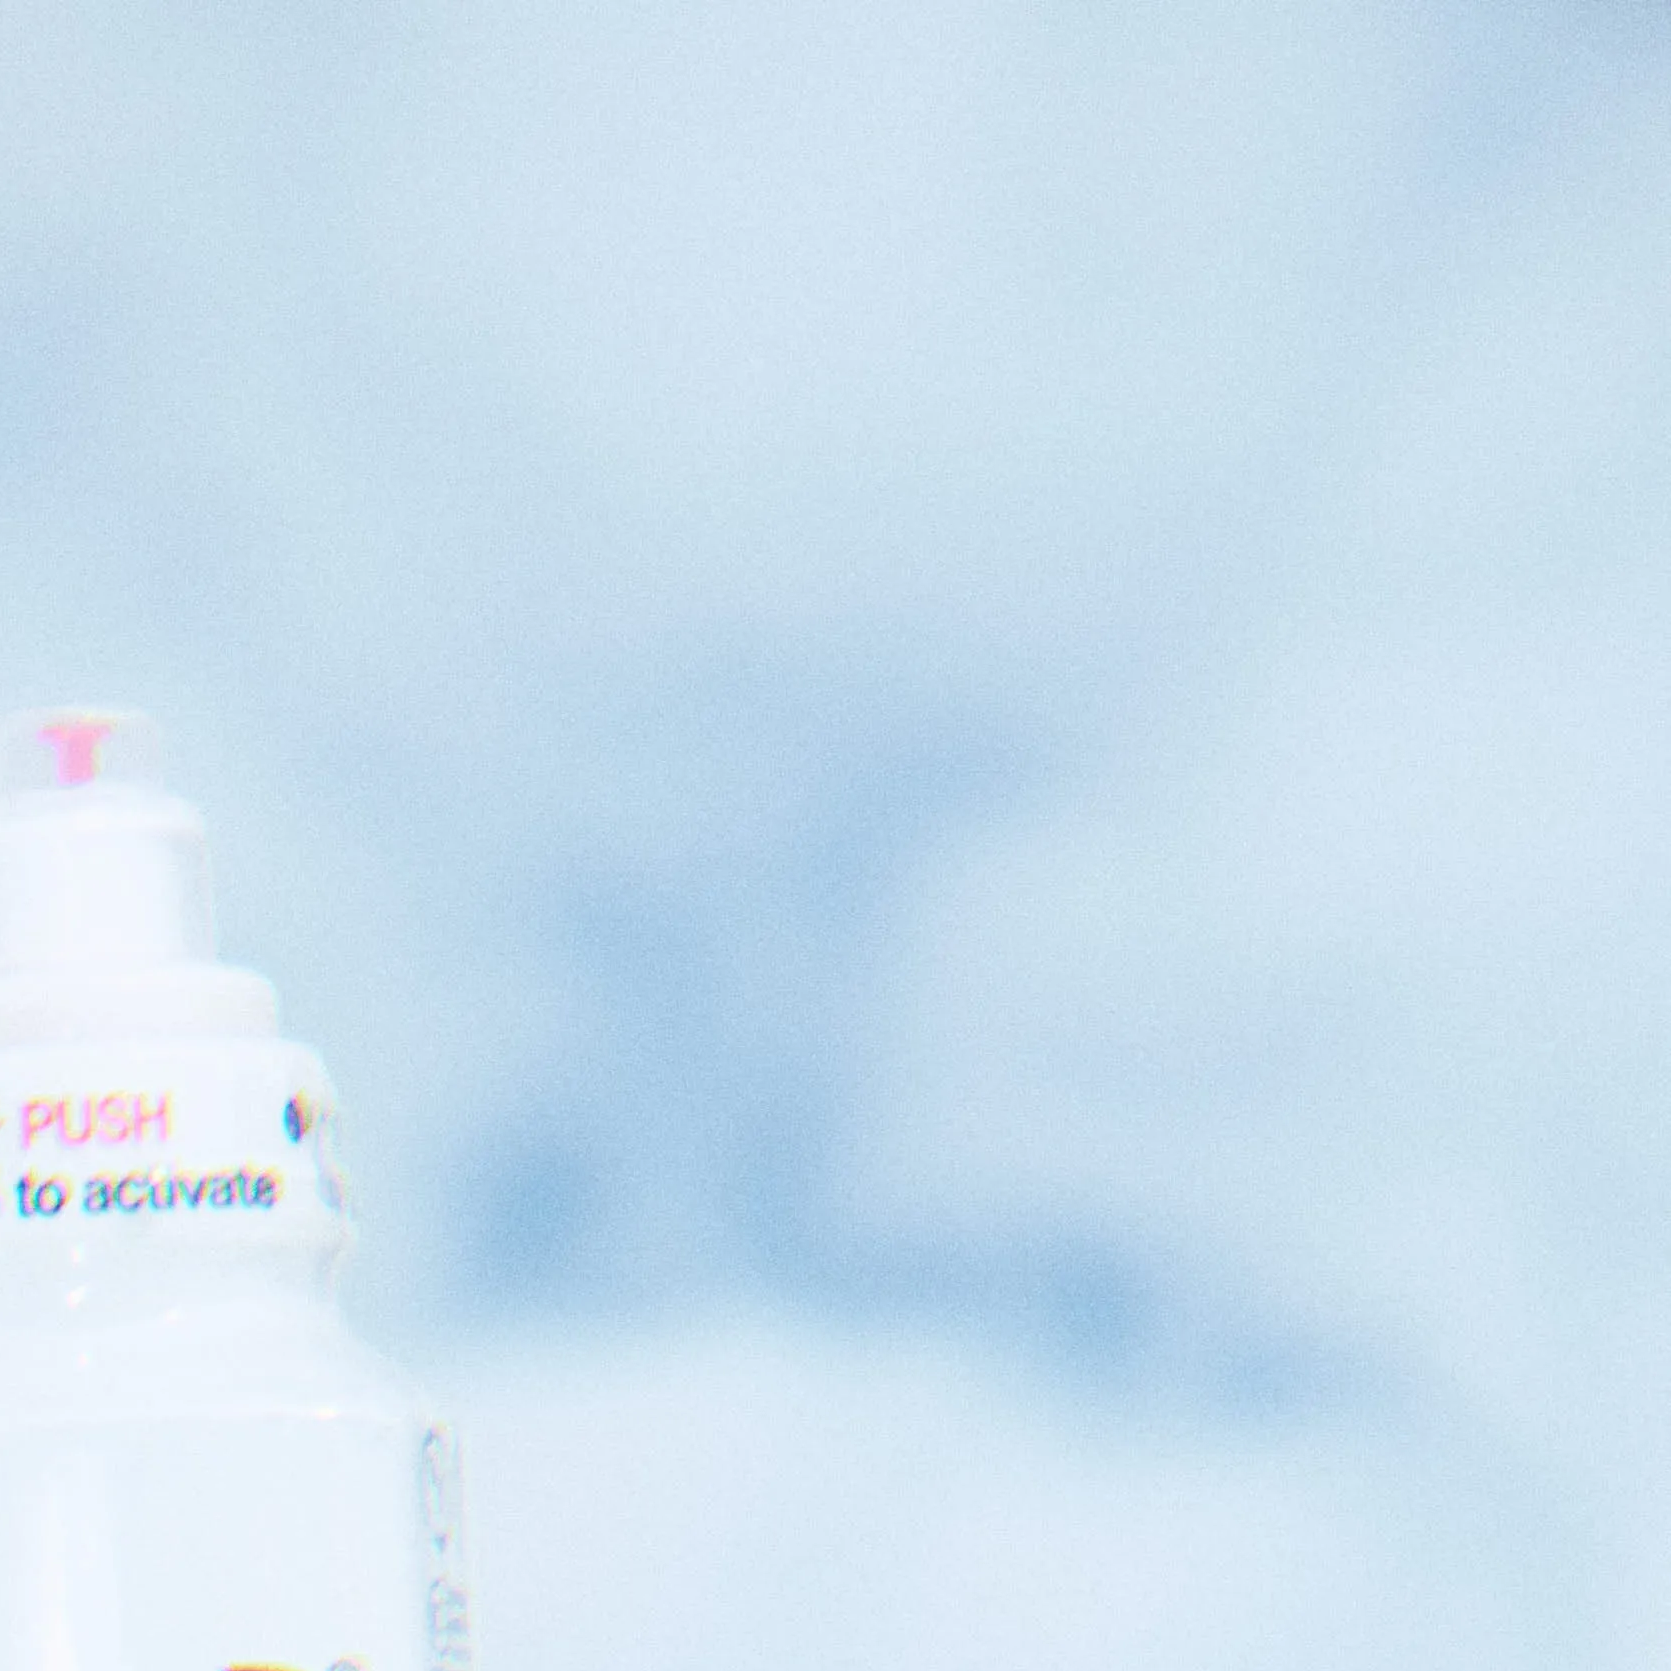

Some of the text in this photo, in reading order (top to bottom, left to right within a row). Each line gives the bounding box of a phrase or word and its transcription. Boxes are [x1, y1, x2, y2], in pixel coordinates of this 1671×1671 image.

[20, 1091, 173, 1148] PUSH
[16, 1164, 281, 1221] to activate
